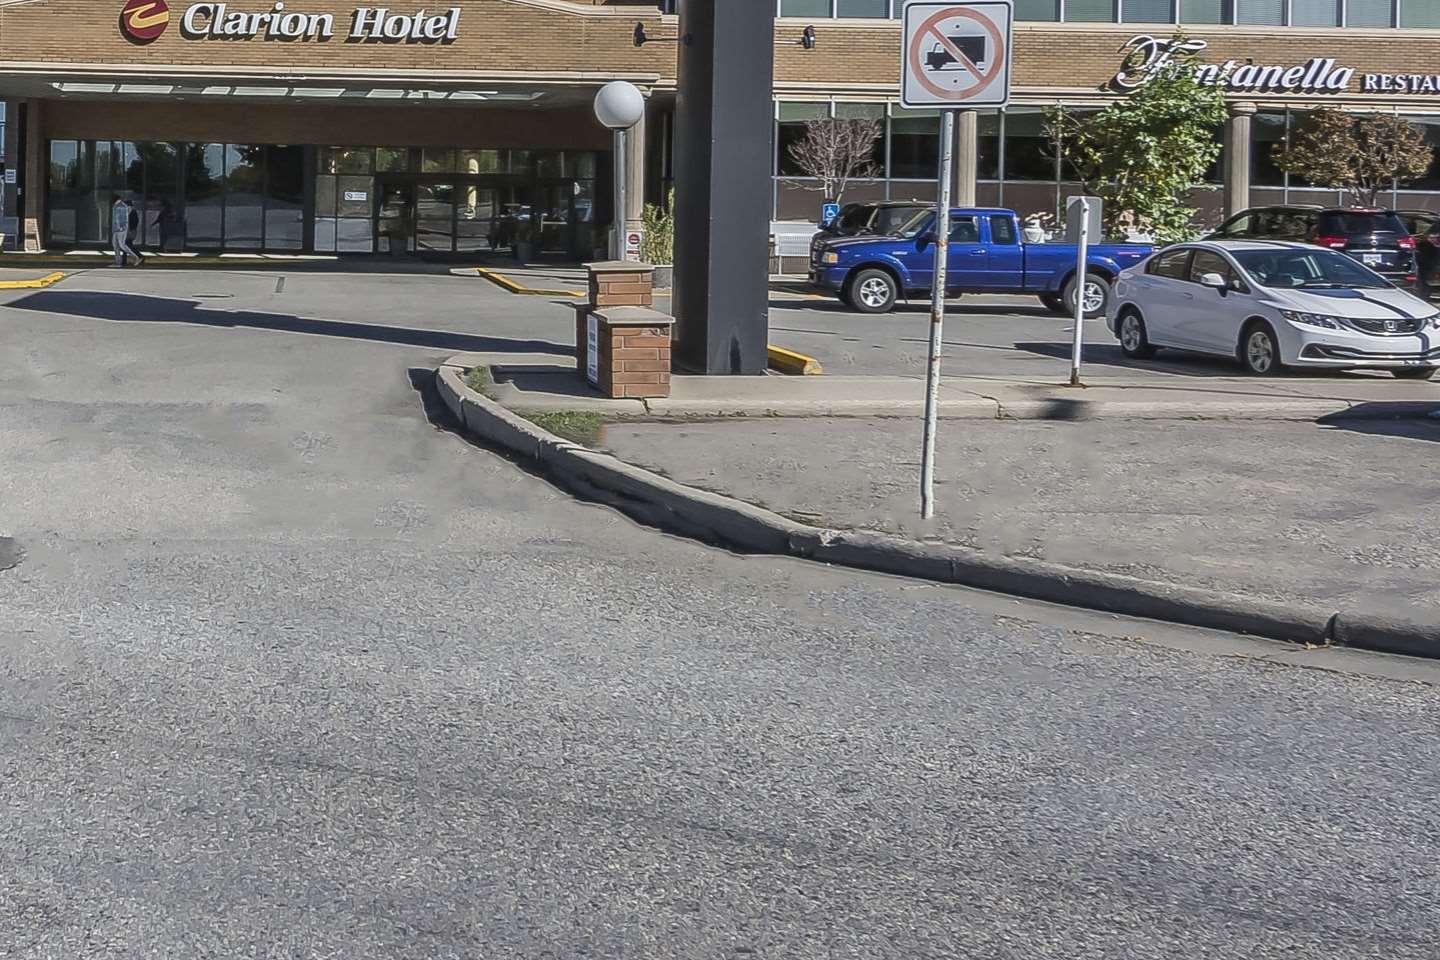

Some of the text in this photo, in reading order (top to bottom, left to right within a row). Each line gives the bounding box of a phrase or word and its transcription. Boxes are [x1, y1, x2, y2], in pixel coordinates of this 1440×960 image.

[181, 2, 462, 41] Clarion Hotel
[1116, 35, 1440, 91] Fntanella RESTA
